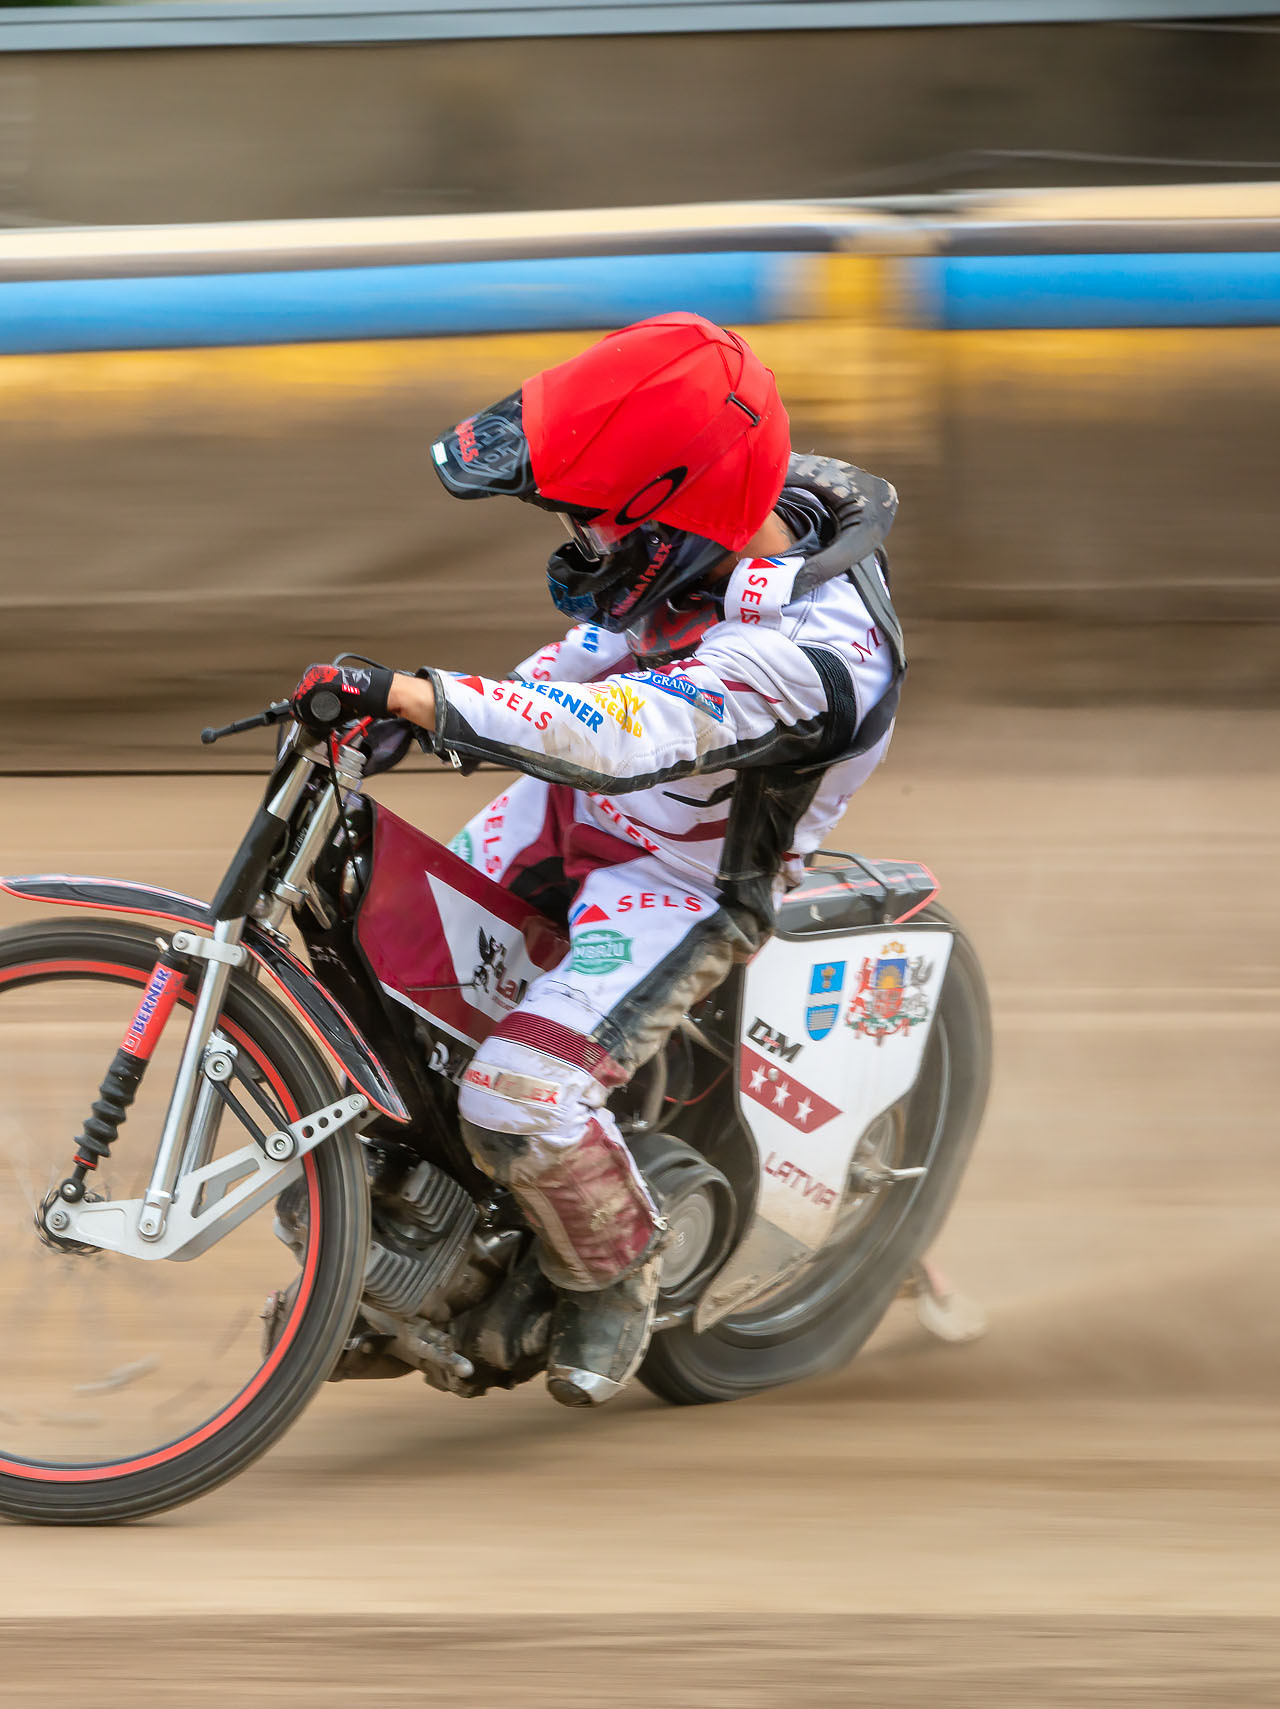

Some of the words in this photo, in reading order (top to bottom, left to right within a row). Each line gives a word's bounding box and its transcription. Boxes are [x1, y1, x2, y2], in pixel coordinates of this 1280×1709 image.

[740, 574, 768, 624] SELS
[491, 687, 553, 731] SELS
[520, 681, 604, 734] BERNER
[652, 674, 697, 696] GRAND
[595, 693, 643, 738] KEBAB
[482, 795, 510, 875] SELS
[616, 892, 703, 913] SELS
[131, 967, 173, 1035] BERNER
[764, 1152, 839, 1210] LATVIA
